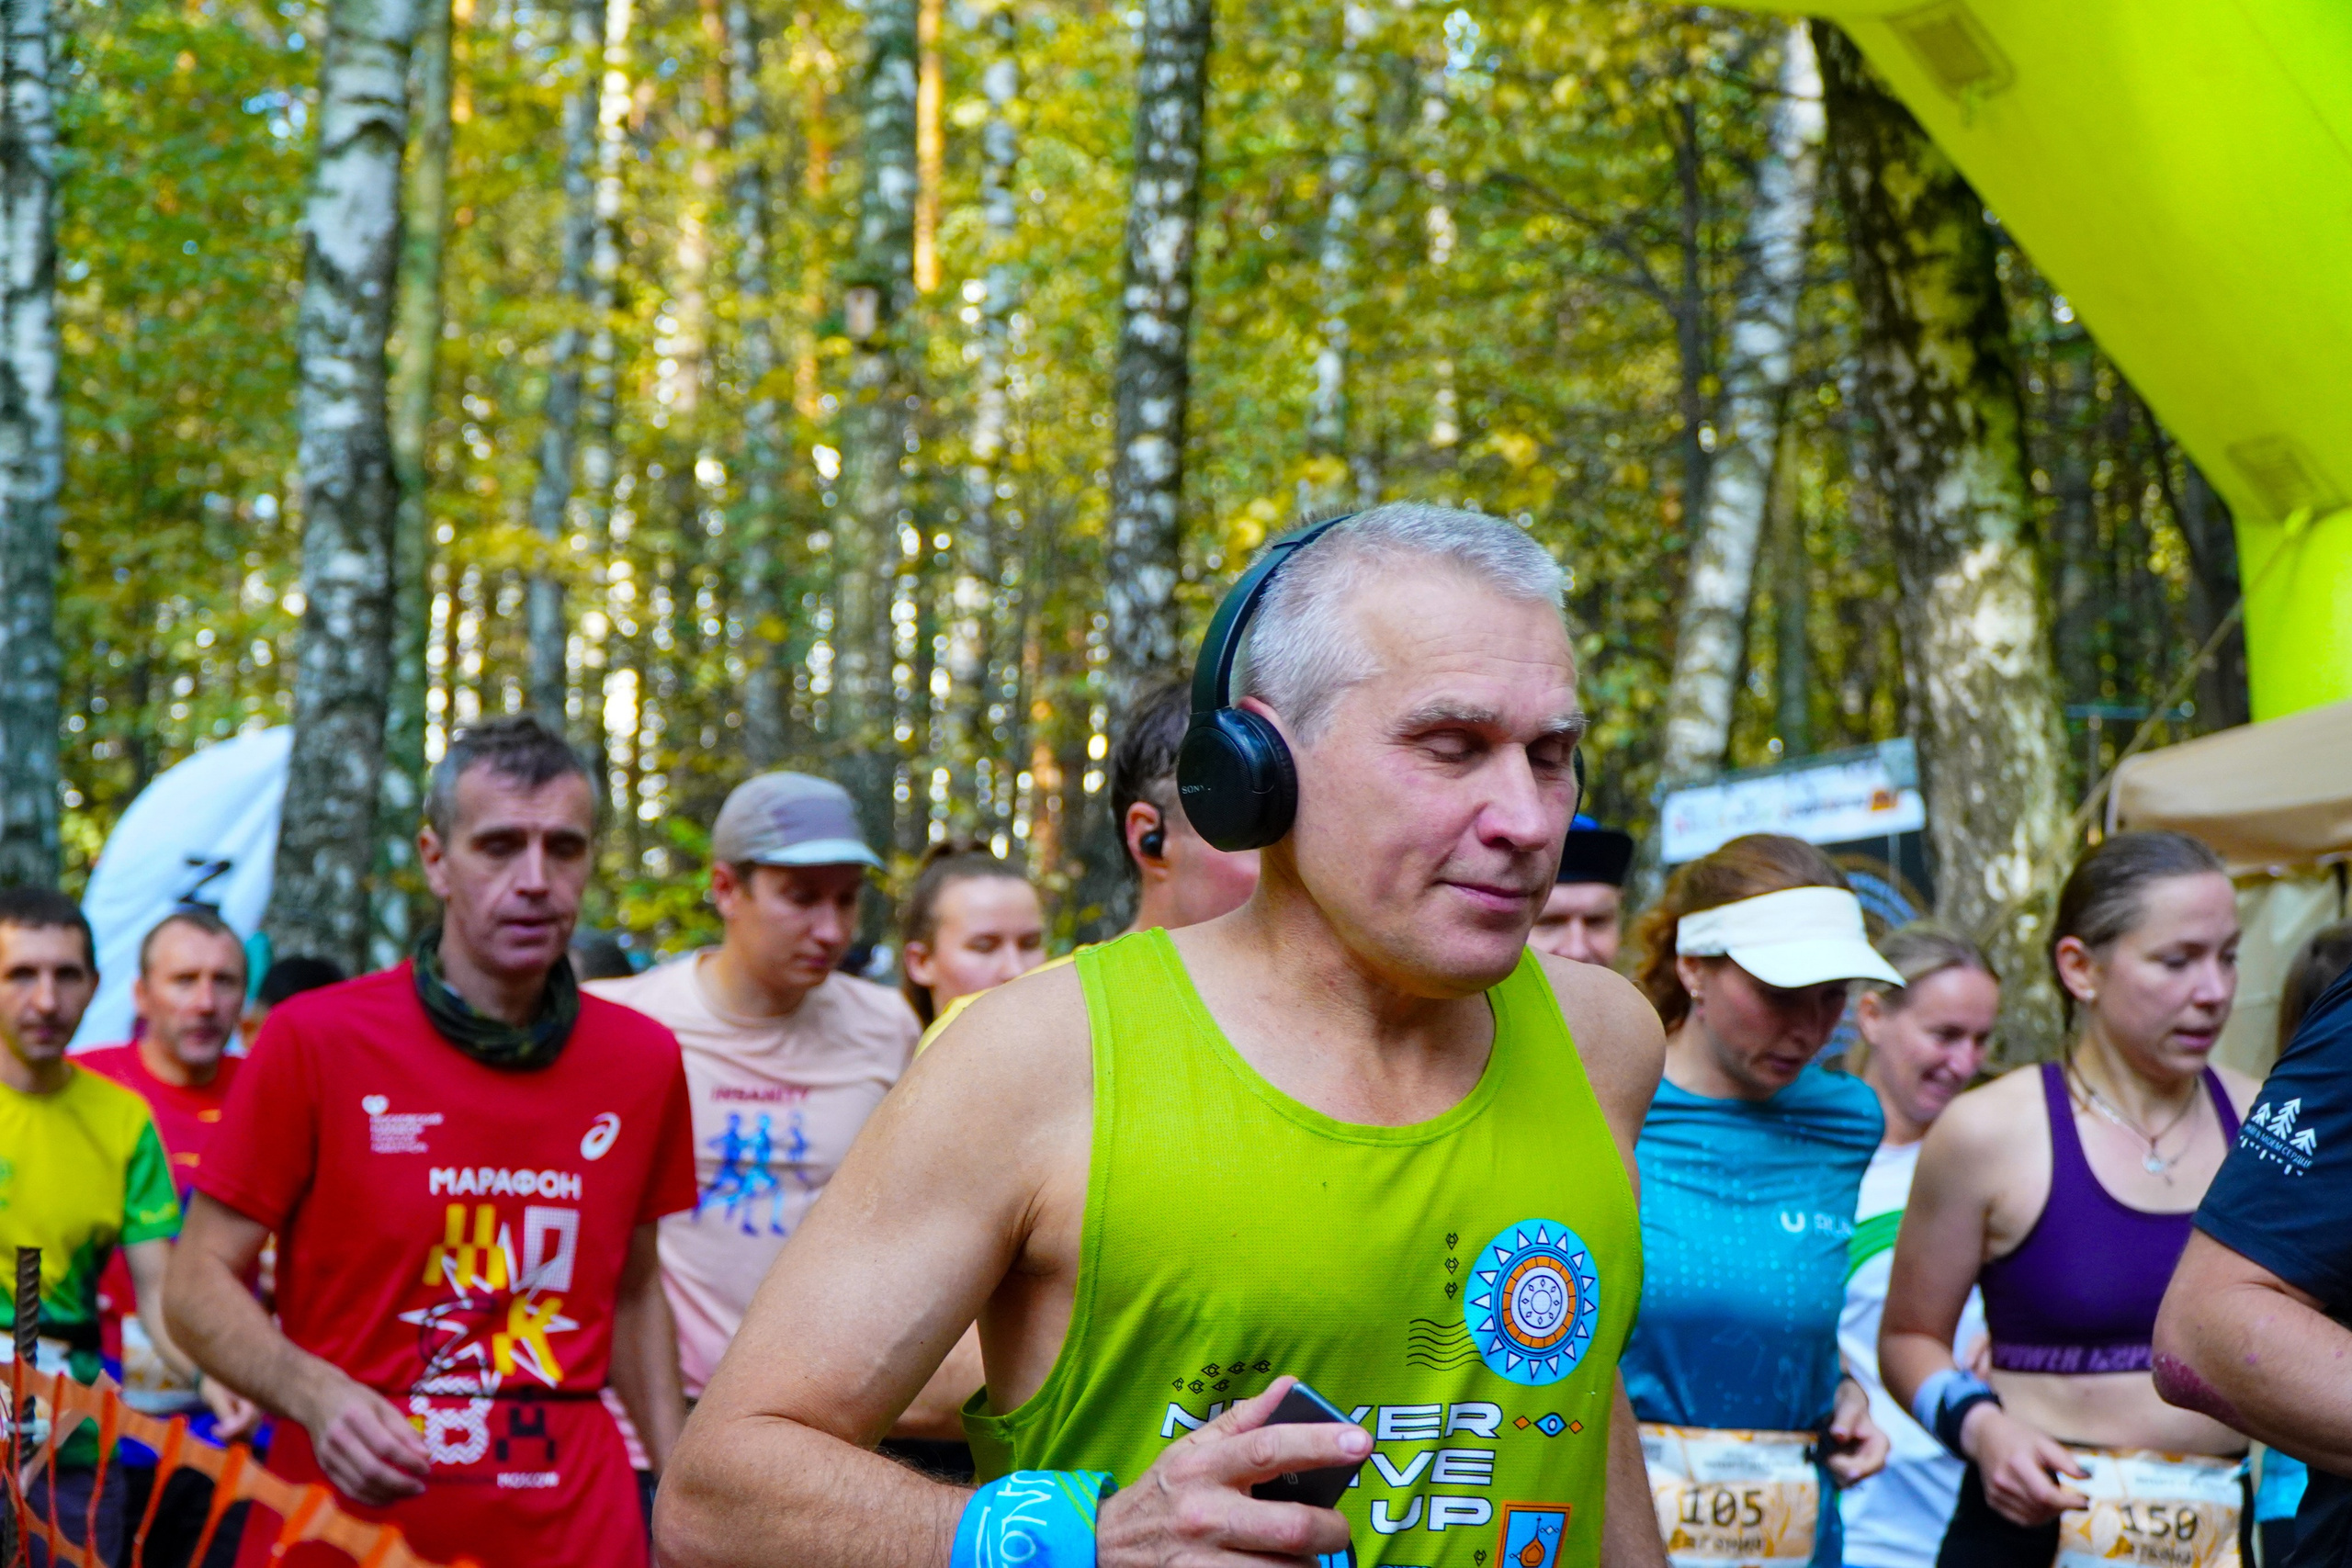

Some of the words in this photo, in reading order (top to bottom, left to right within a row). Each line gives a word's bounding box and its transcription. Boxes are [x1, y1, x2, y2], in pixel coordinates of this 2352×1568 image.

[429, 1166, 582, 1201] МАРАФОН
[1159, 1400, 1504, 1441] NER
[1370, 1495, 1494, 1535] UP
[1679, 1488, 1765, 1528] 105
[2120, 1504, 2199, 1542] 150
